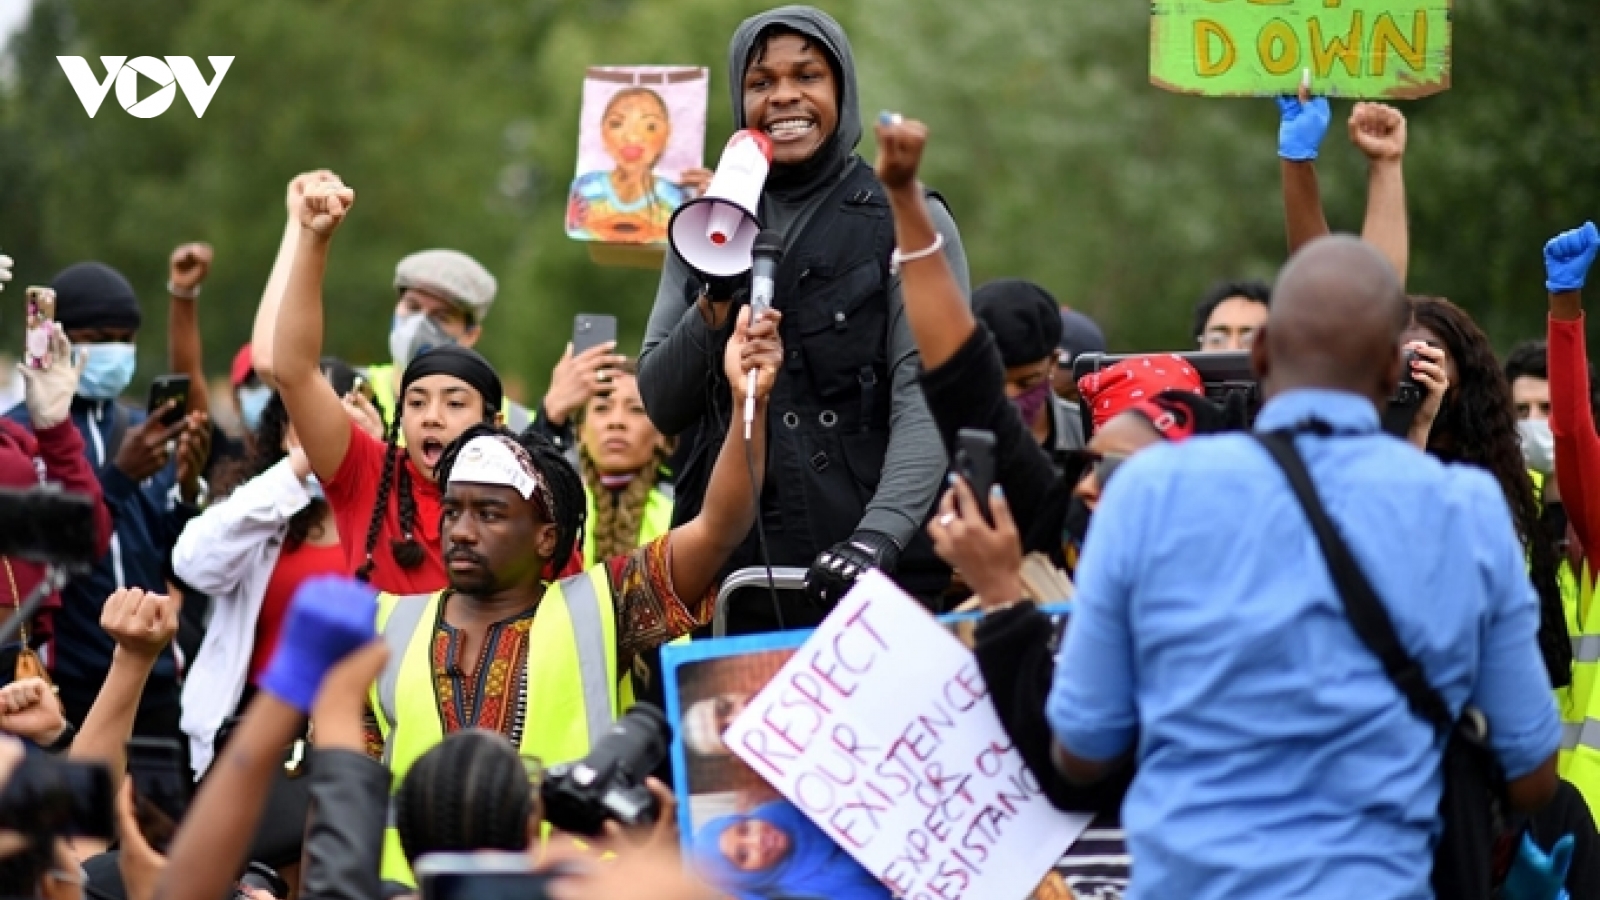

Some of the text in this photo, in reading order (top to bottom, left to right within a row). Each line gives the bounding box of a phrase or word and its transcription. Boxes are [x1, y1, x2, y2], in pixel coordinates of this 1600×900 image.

[1193, 10, 1428, 78] DOWN
[740, 600, 889, 777] RESPECT
[794, 723, 880, 814] OUR
[829, 662, 986, 849] EXISTENCE
[882, 774, 974, 895] EXPECT
